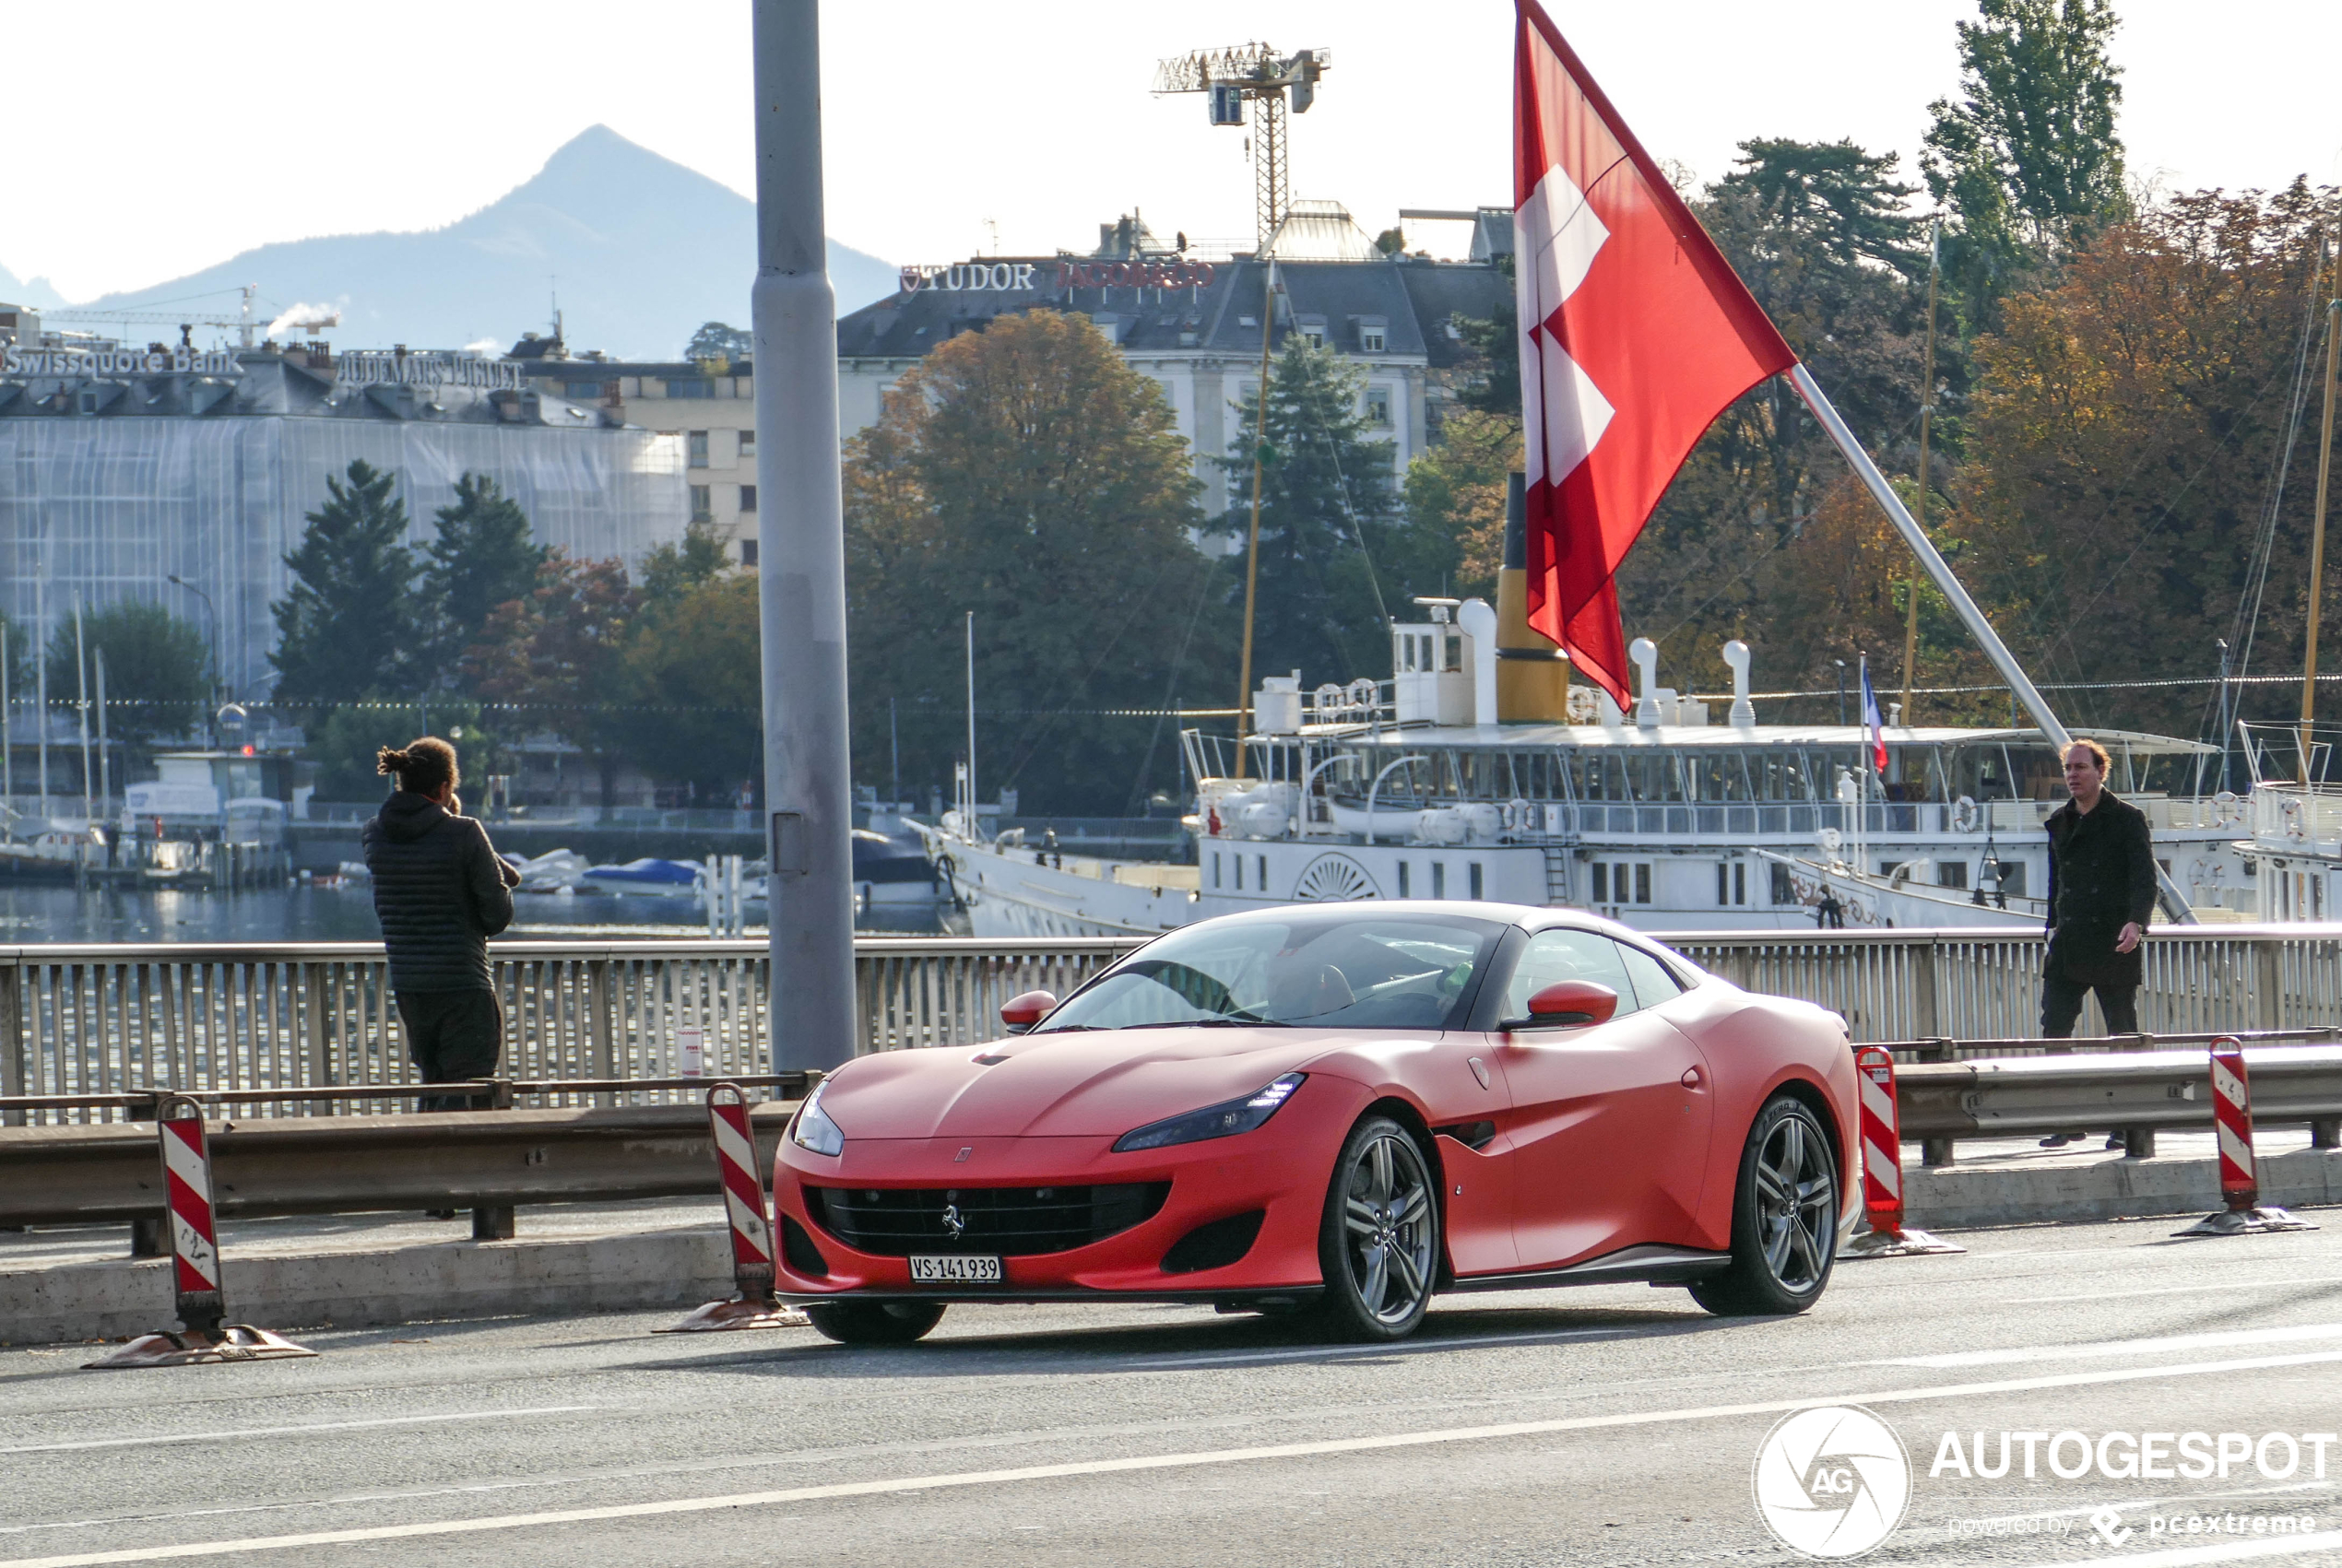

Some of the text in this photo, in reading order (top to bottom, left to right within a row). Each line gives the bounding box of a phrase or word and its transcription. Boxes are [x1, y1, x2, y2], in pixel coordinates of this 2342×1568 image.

[921, 264, 1034, 290] TUDOR
[1056, 262, 1148, 289] JACOB
[6, 345, 244, 382] Swissquote Bank
